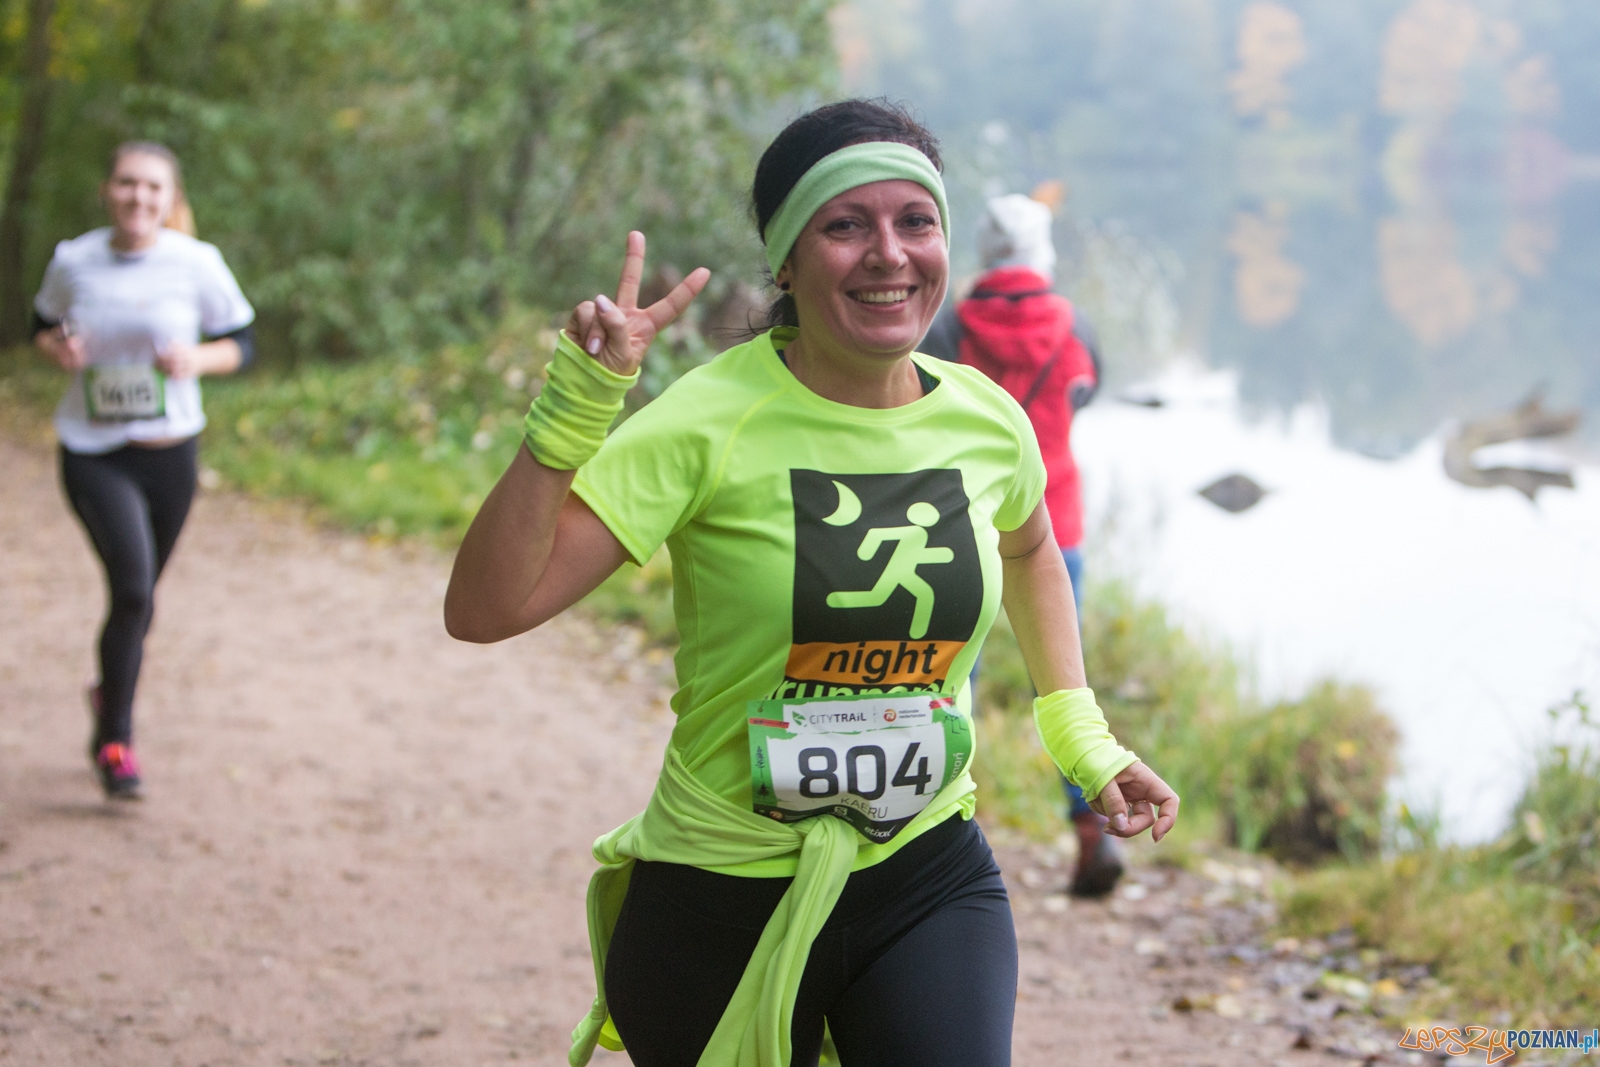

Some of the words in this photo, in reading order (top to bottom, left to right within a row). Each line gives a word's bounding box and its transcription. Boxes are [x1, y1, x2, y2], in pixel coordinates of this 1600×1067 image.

[822, 642, 938, 684] night
[798, 741, 932, 801] 804
[946, 752, 964, 785] znań
[840, 797, 889, 819] KAERU
